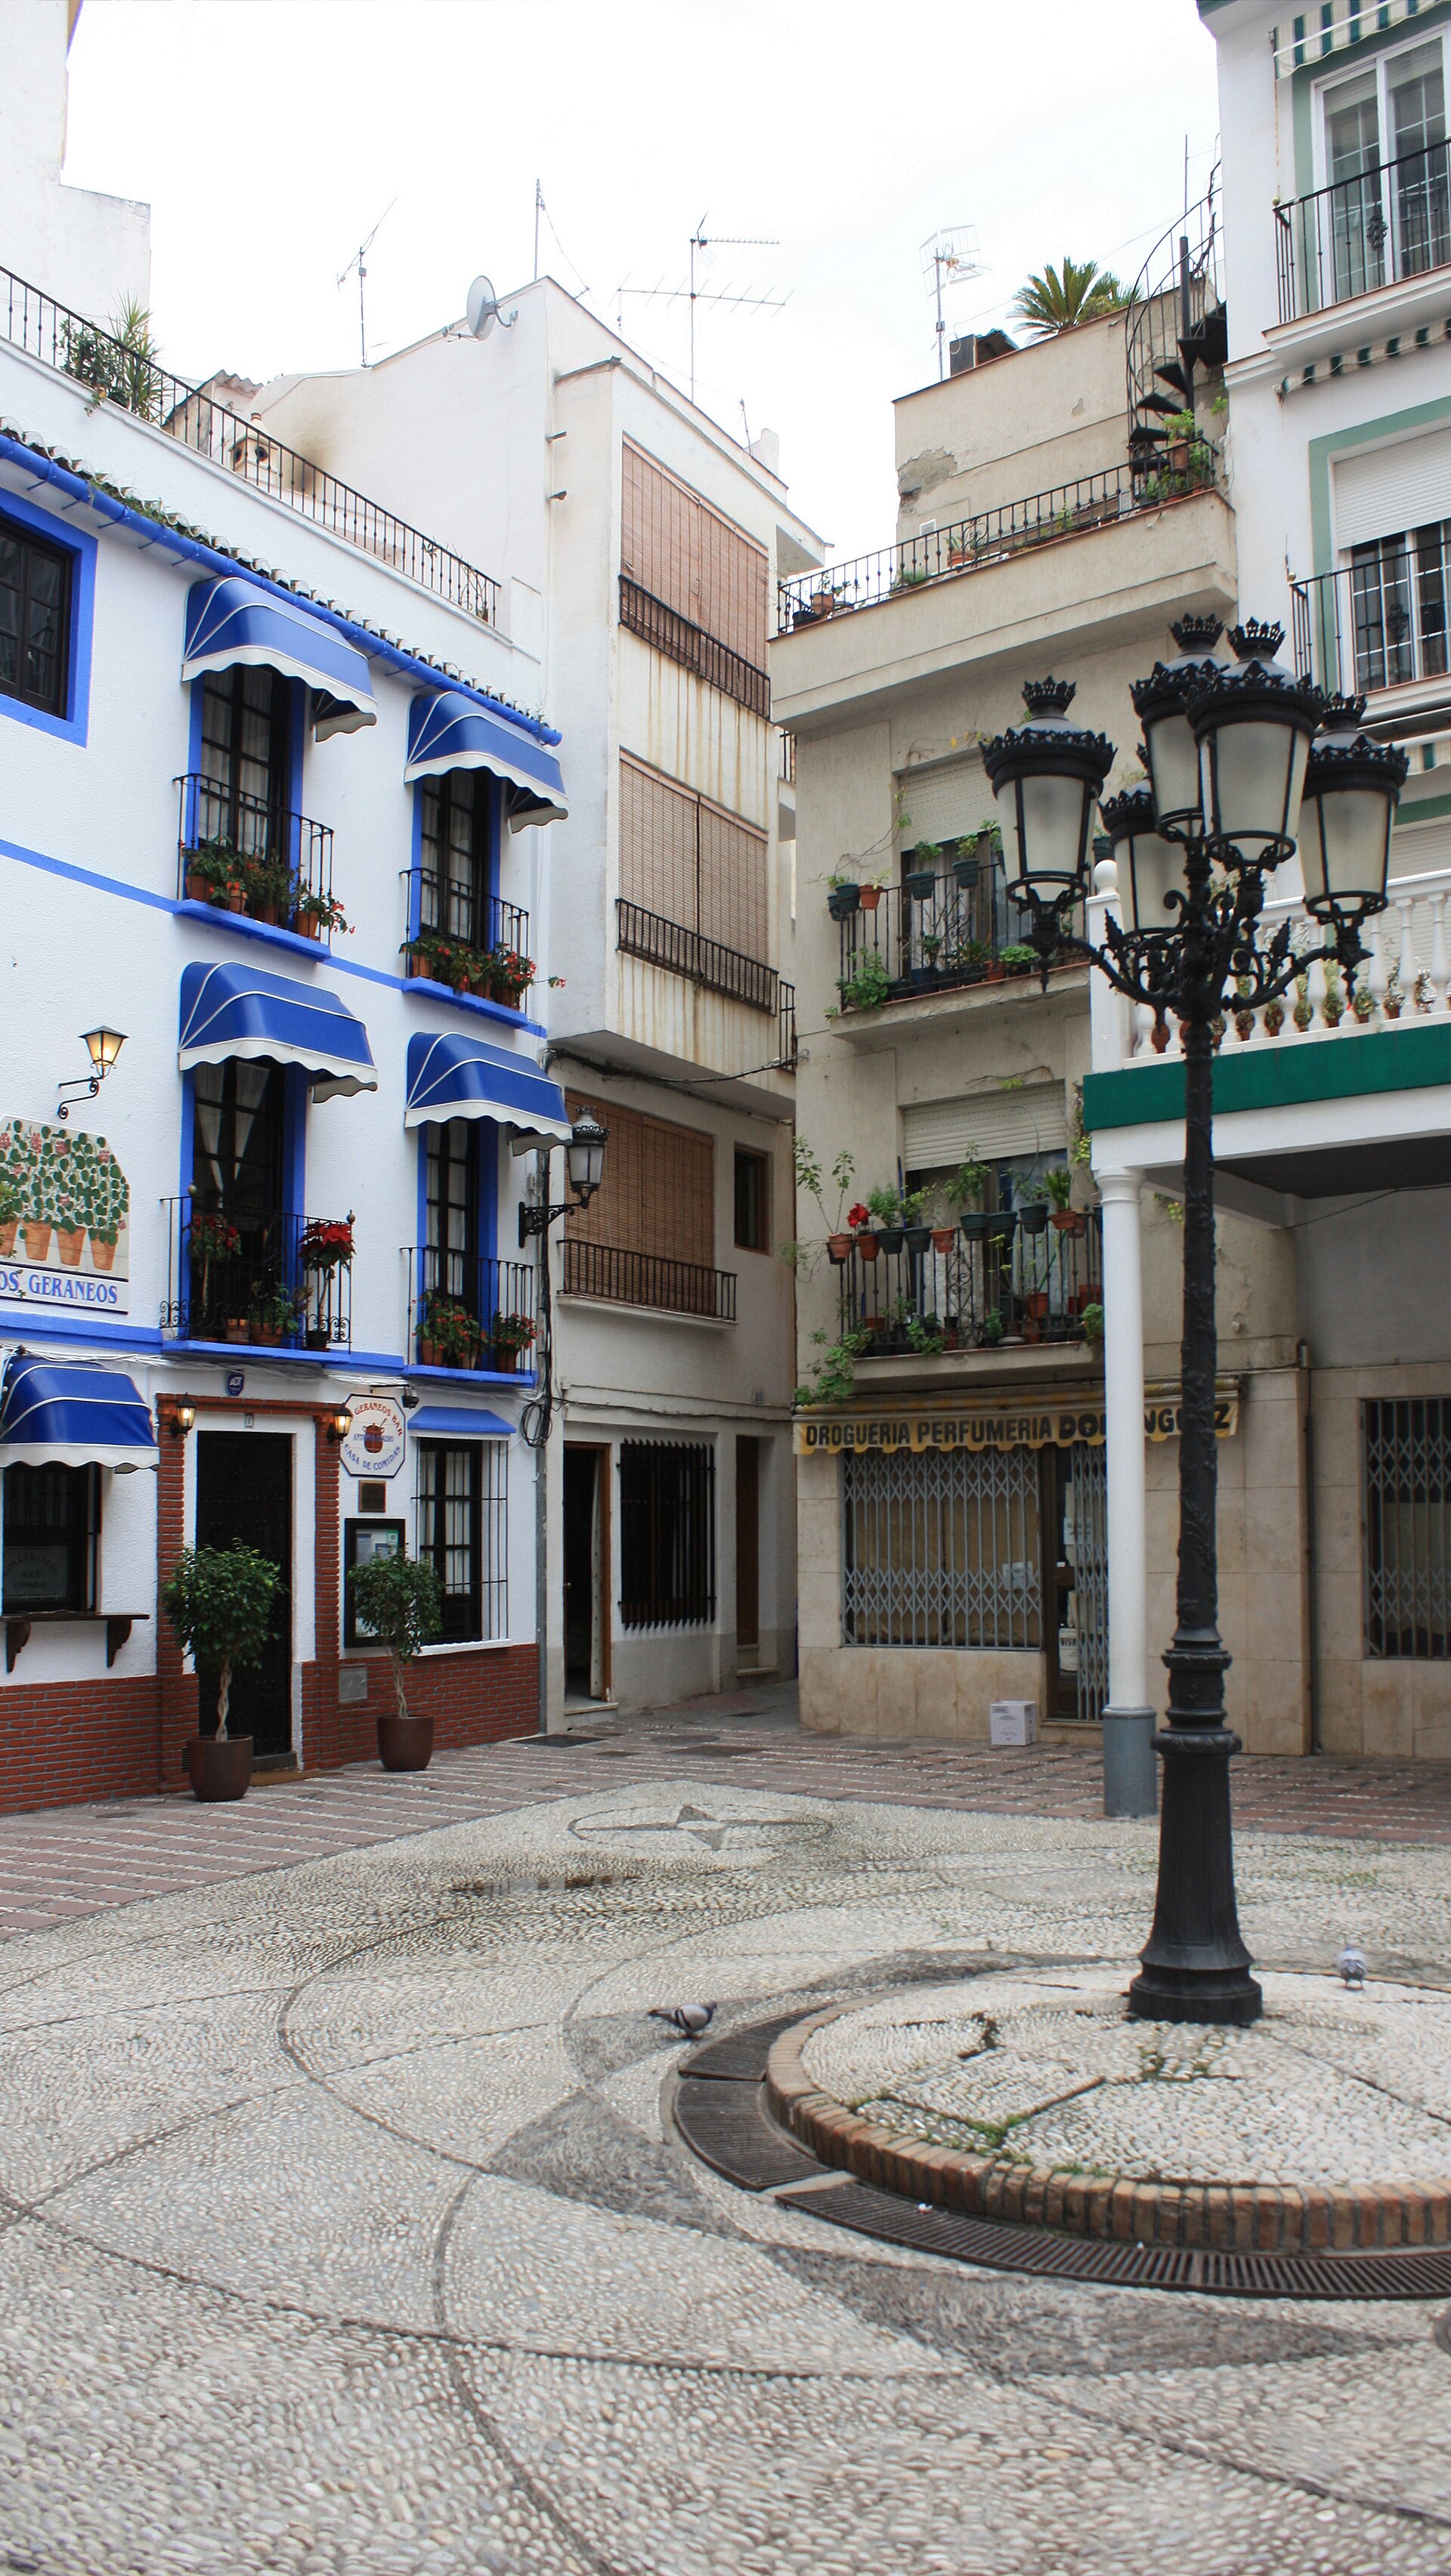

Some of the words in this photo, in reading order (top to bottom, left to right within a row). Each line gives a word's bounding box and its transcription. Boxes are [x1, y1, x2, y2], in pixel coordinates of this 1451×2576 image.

[28, 1273, 118, 1304] GERANEOS
[354, 1402, 392, 1417] GERANEOS
[391, 1415, 403, 1436] BAR
[806, 1421, 911, 1446] DROGUERIA
[917, 1415, 1053, 1444] PERFUMERIA
[1059, 1403, 1230, 1440] DONGZ
[344, 1443, 360, 1465] CASA
[363, 1460, 372, 1470] DE
[373, 1445, 401, 1470] COMIDAS
